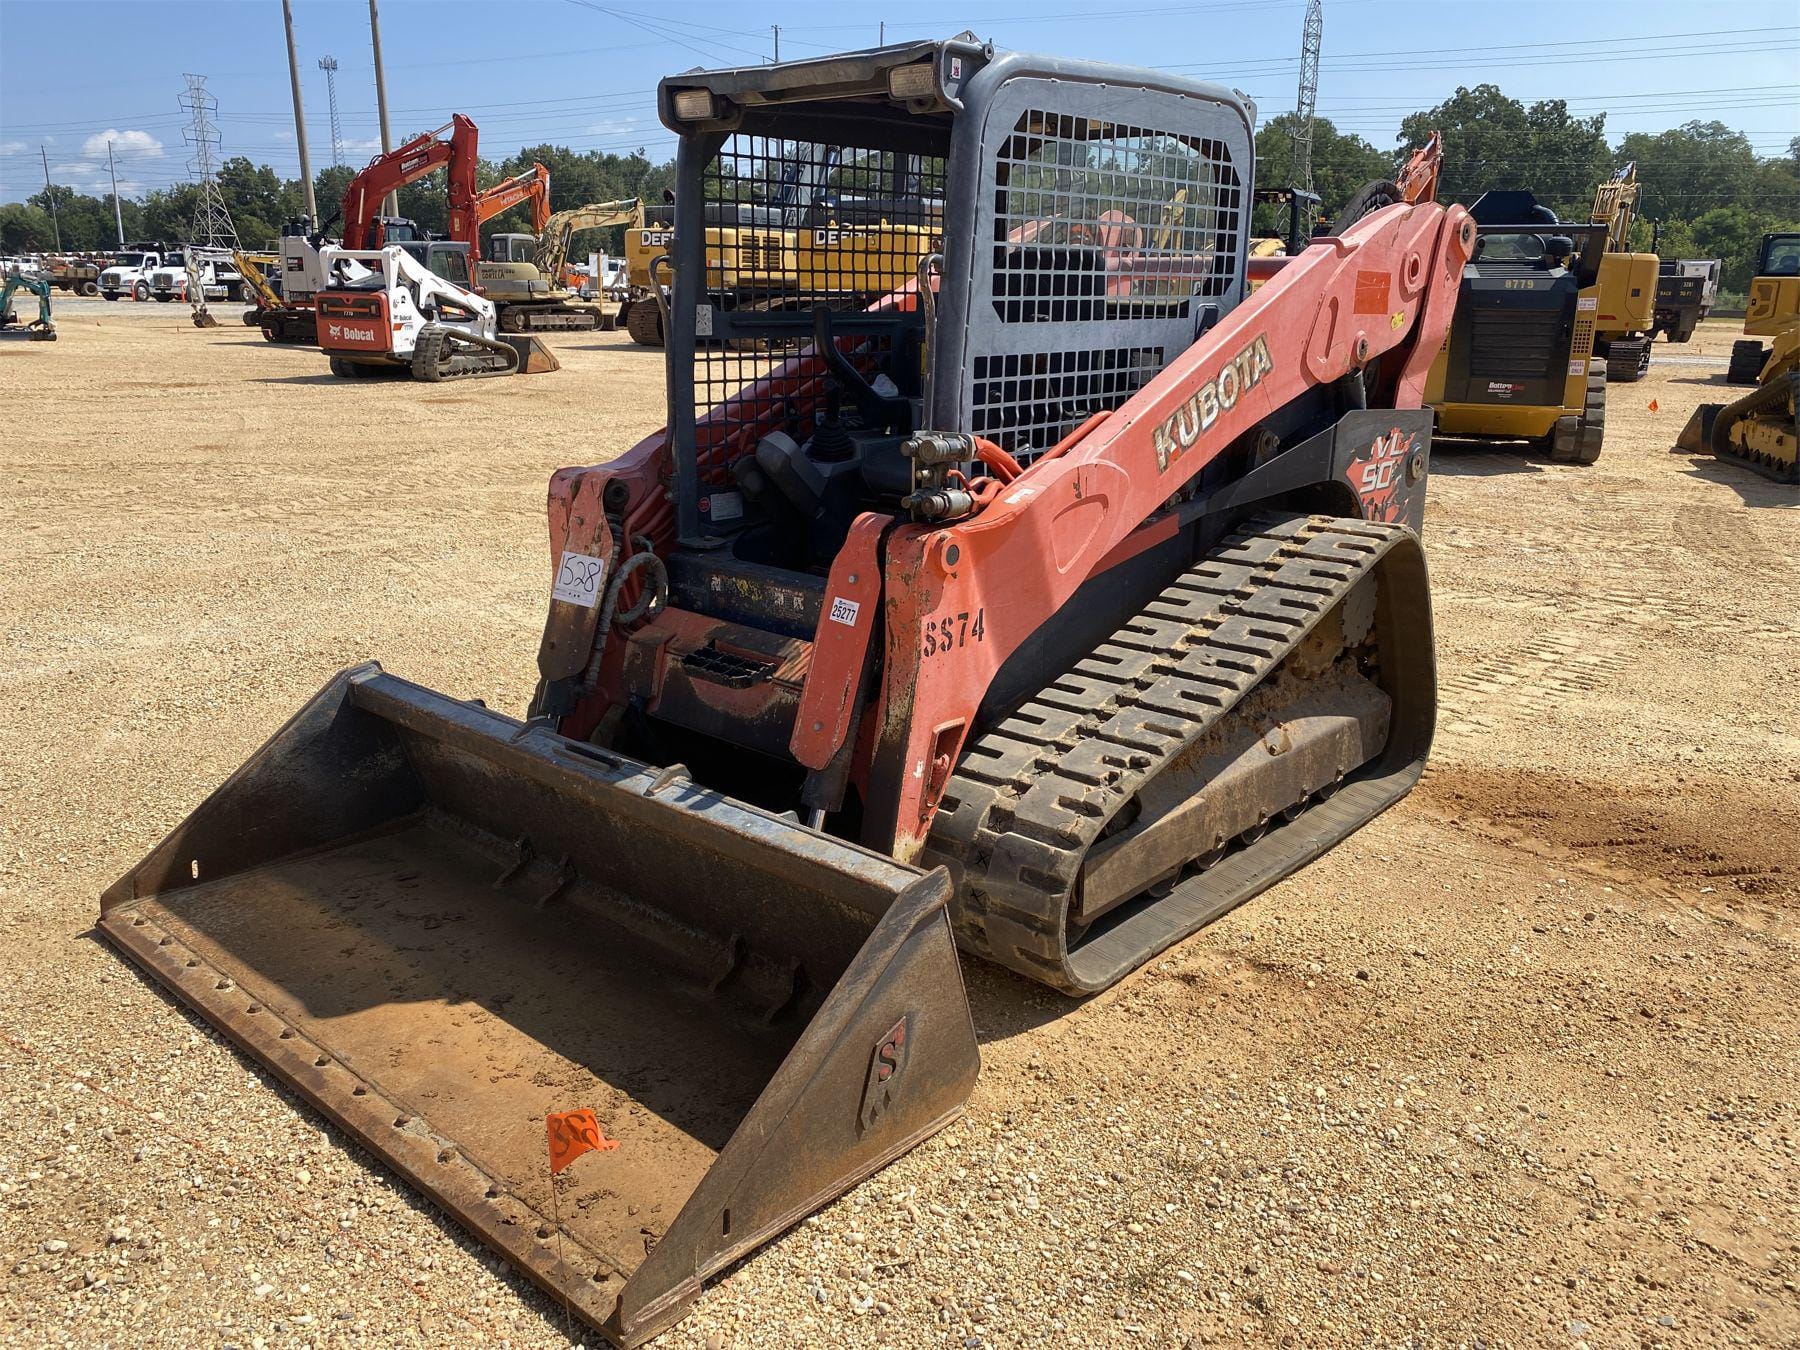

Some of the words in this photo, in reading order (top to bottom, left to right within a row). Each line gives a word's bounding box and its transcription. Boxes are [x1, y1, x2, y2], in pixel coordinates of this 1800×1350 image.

[641, 231, 675, 246] DEE
[1505, 279, 1534, 289] 8779
[343, 326, 375, 341] Bobcat
[1154, 336, 1272, 474] KUBOTA
[832, 604, 856, 622] 25277
[923, 608, 984, 657] SS74
